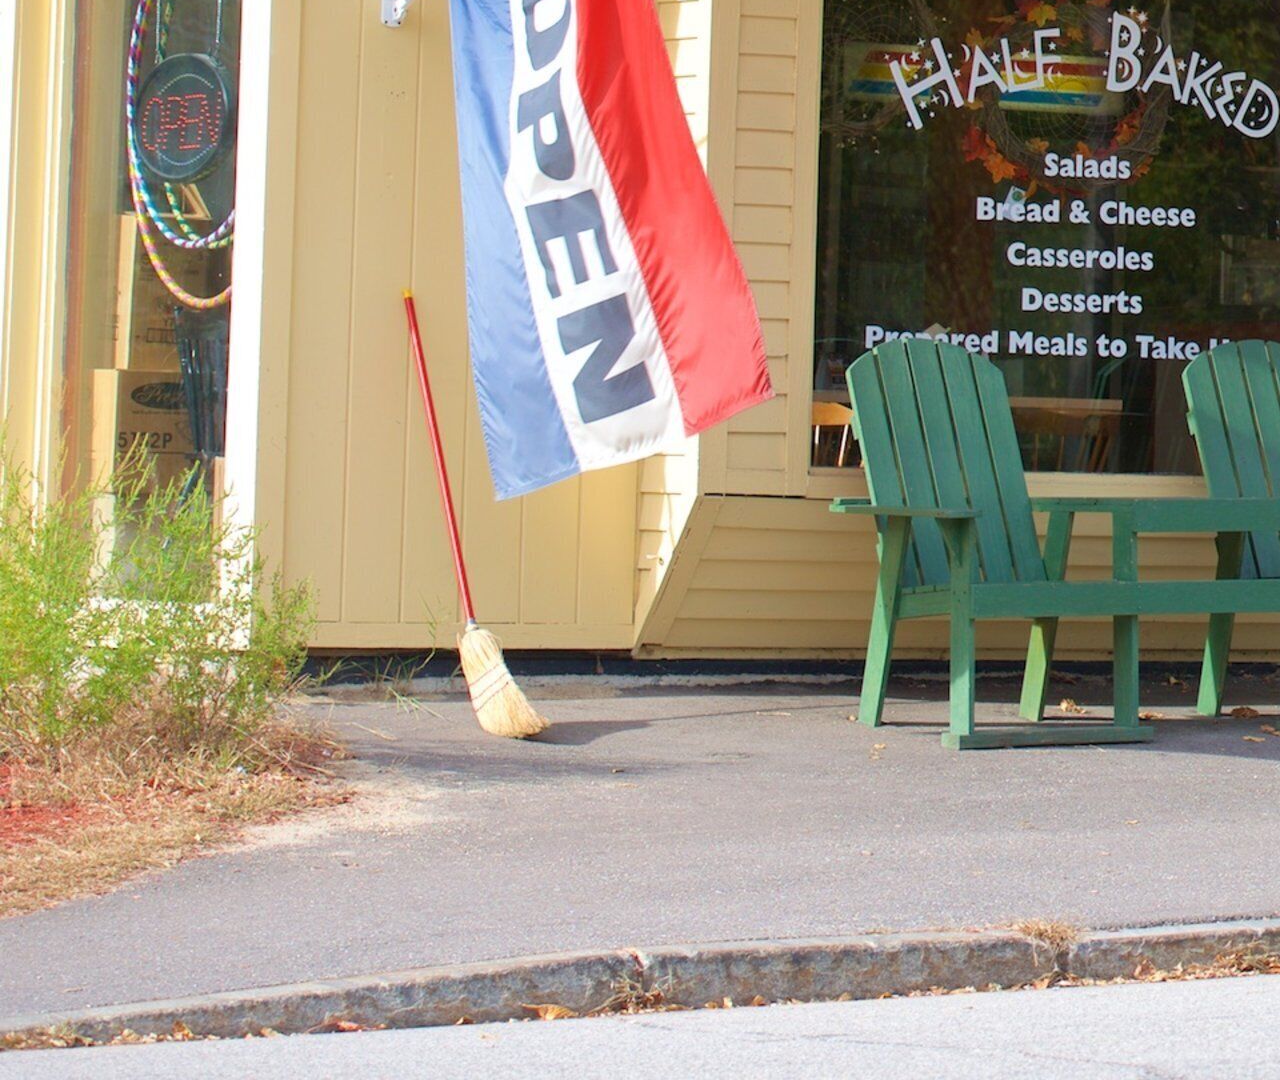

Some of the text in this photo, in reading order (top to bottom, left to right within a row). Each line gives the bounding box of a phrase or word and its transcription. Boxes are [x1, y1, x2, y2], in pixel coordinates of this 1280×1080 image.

[889, 10, 1280, 138] HALF BAKED
[141, 91, 222, 151] OPEN
[1044, 152, 1132, 180] Salads
[976, 197, 1197, 228] Bread & Cheese
[1006, 241, 1155, 272] Casseroles
[1020, 287, 1143, 315] Desserts
[865, 324, 999, 354] Prred
[1008, 330, 1088, 358] Meals
[1096, 333, 1128, 358] to
[1135, 334, 1201, 361] Take
